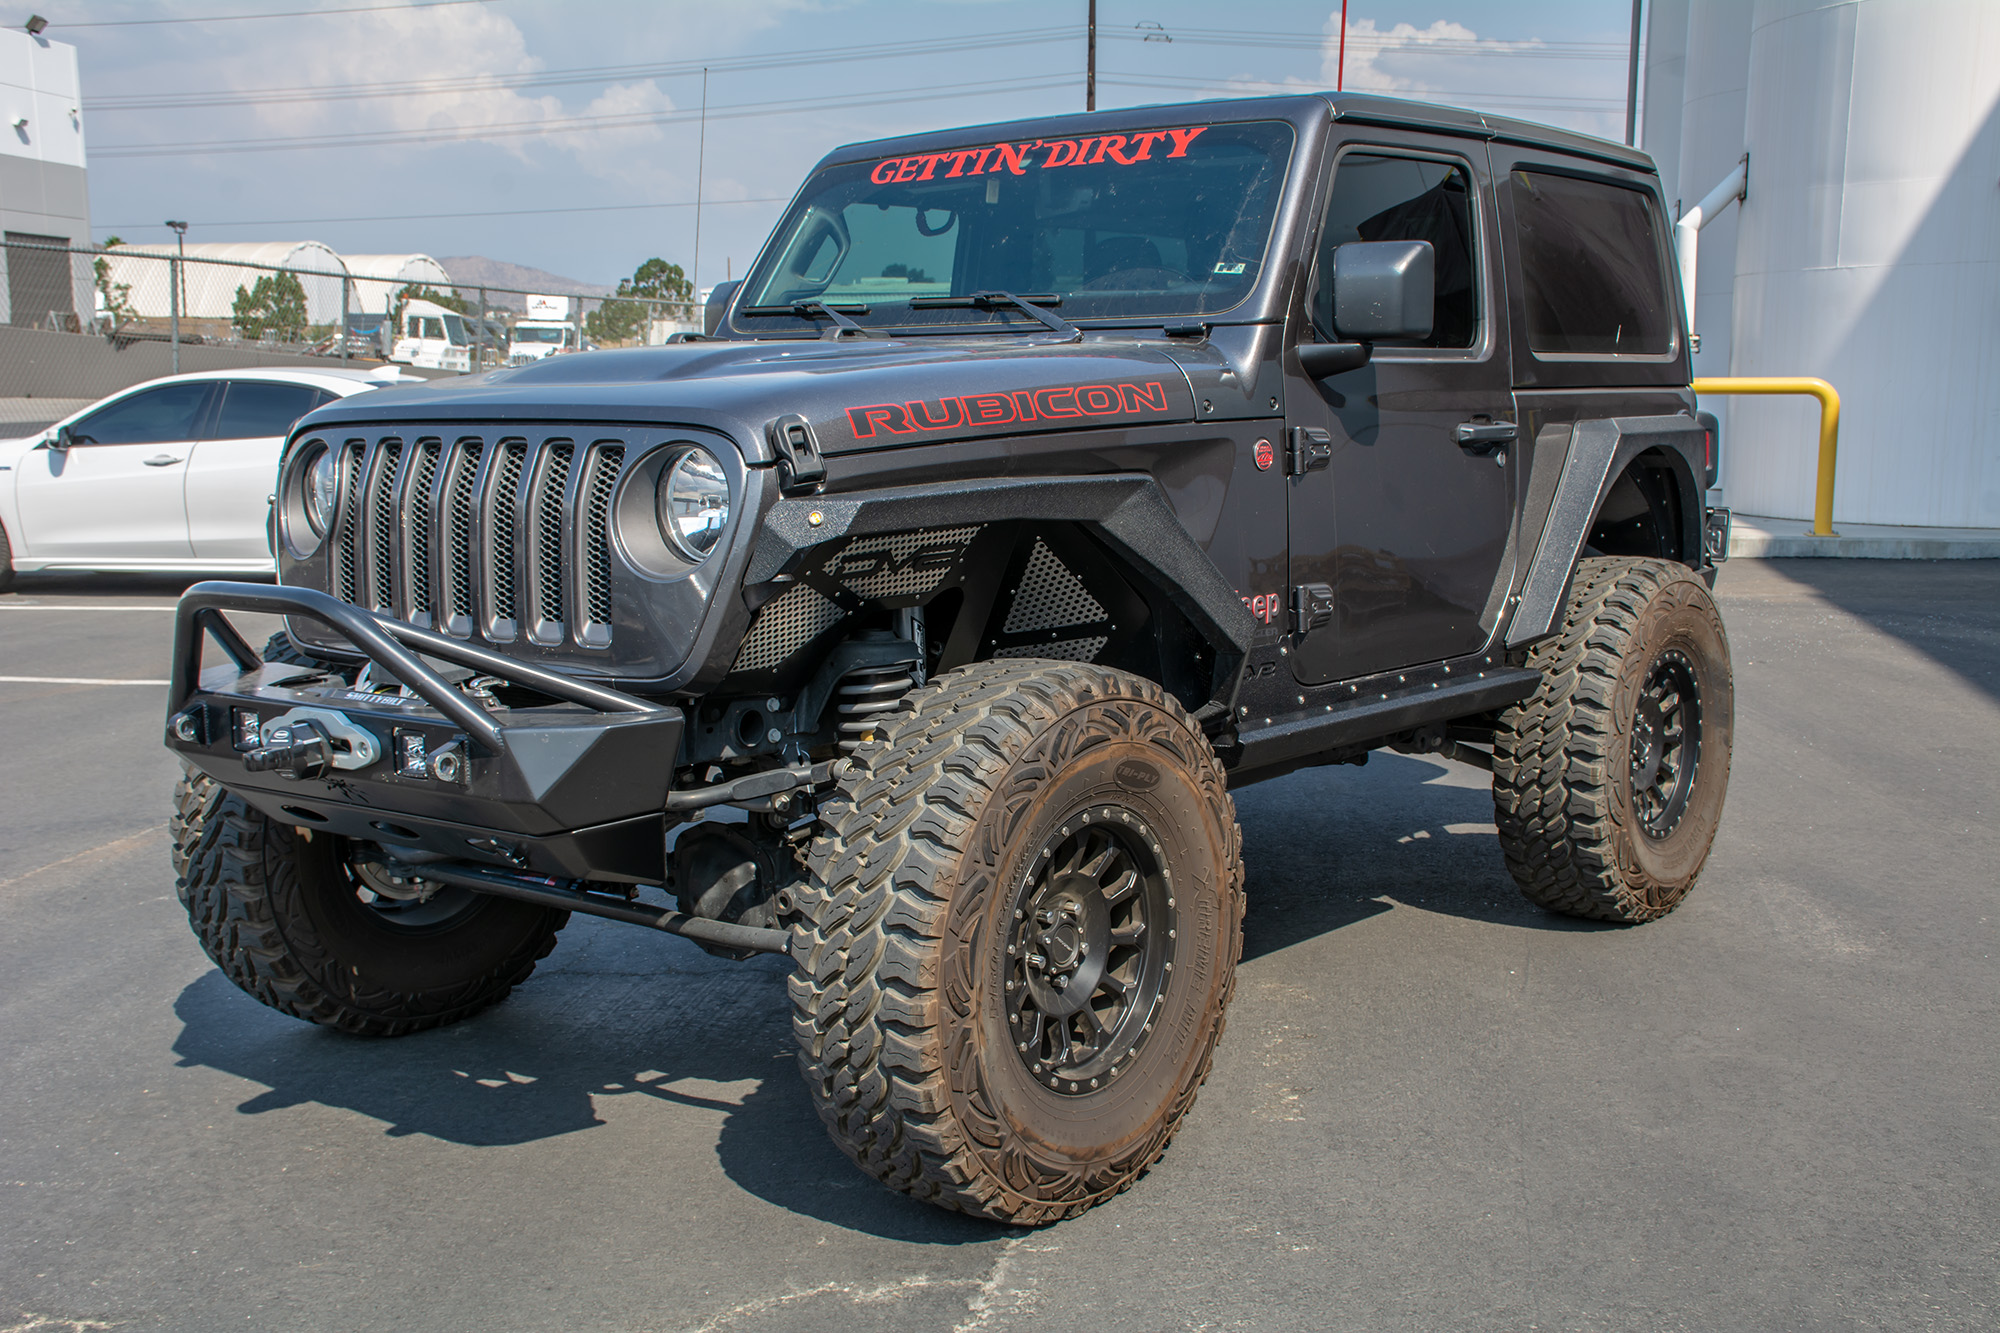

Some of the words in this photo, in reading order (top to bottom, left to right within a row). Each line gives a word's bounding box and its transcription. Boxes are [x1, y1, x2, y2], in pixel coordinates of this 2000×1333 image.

[1041, 127, 1208, 169] DIRTY
[844, 382, 1168, 439] RUBICON
[344, 691, 407, 706] SMITTYBILT
[1117, 765, 1159, 784] TRI-PLY
